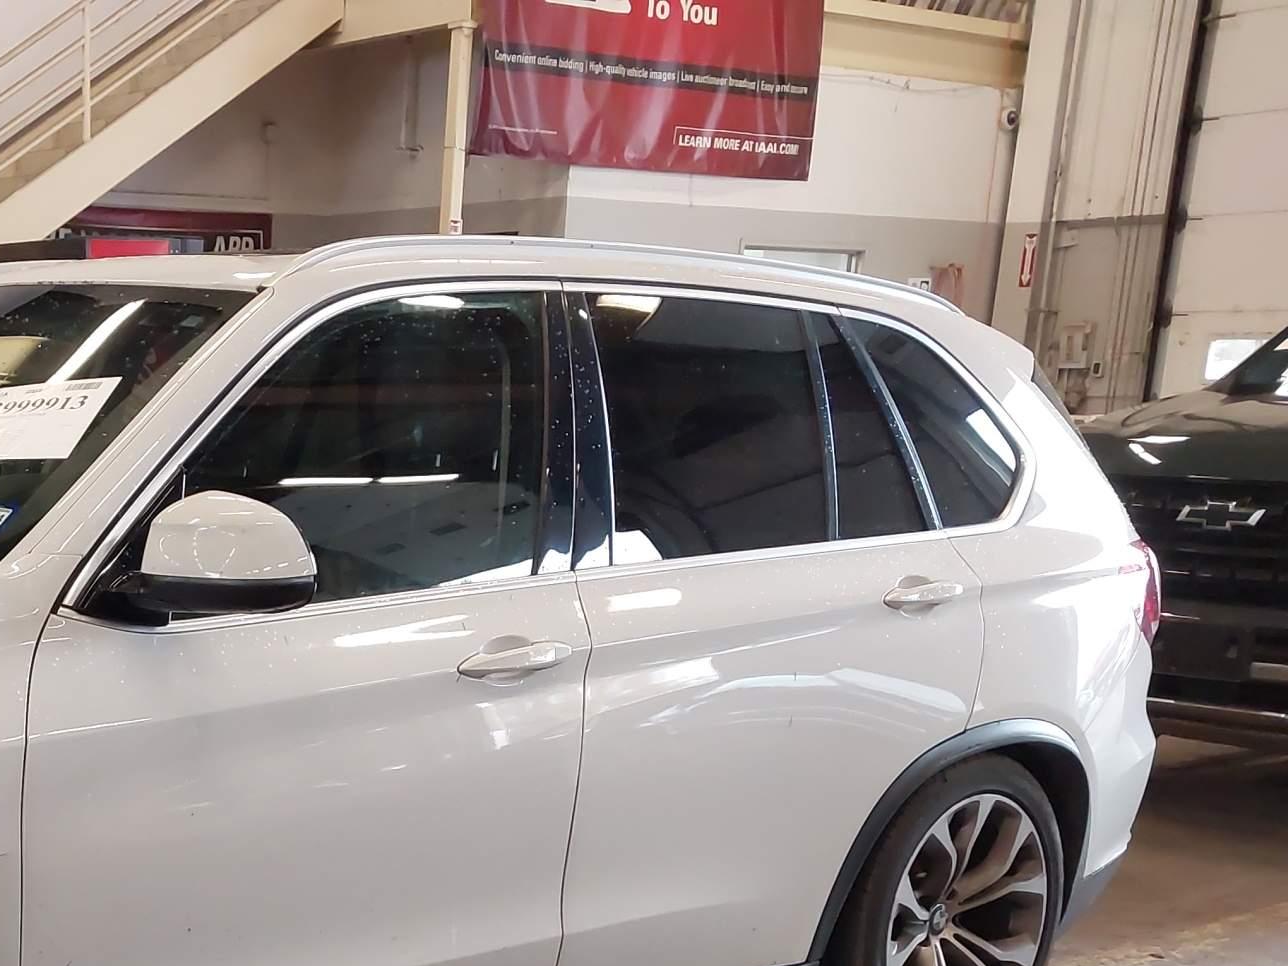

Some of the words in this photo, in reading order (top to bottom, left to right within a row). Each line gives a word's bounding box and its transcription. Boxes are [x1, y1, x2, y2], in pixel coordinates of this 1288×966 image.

[680, 0, 718, 26] You
[494, 49, 536, 65] Convenient
[537, 55, 557, 68] online
[559, 56, 584, 73] bidding
[649, 68, 676, 82] images
[678, 134, 711, 148] LEARN
[713, 137, 740, 151] MORE
[741, 140, 754, 152] AT
